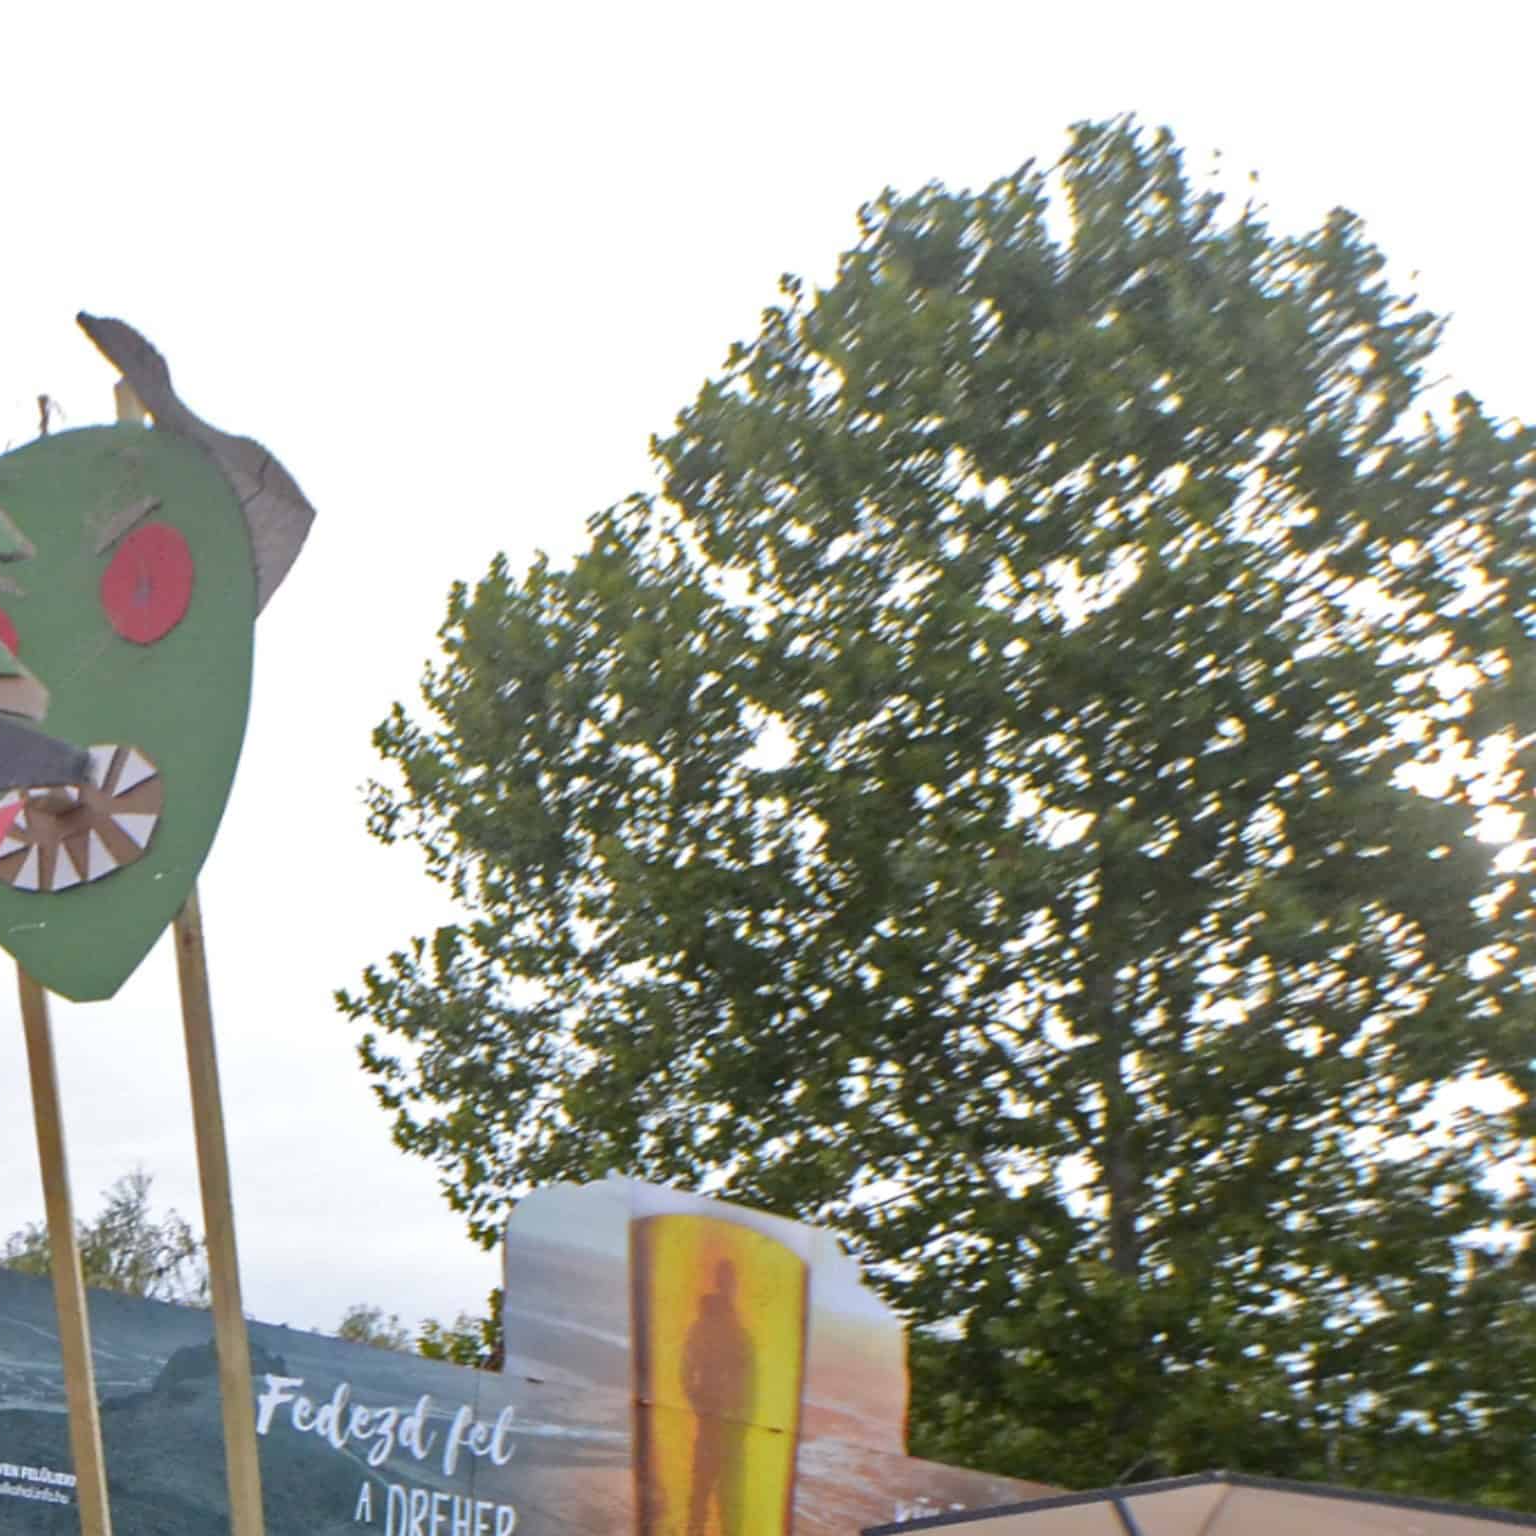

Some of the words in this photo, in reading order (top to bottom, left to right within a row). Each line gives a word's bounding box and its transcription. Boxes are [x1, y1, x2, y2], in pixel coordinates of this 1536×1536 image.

[255, 1373, 437, 1466] Fedezd
[443, 1405, 516, 1476] fel
[354, 1481, 372, 1522] A
